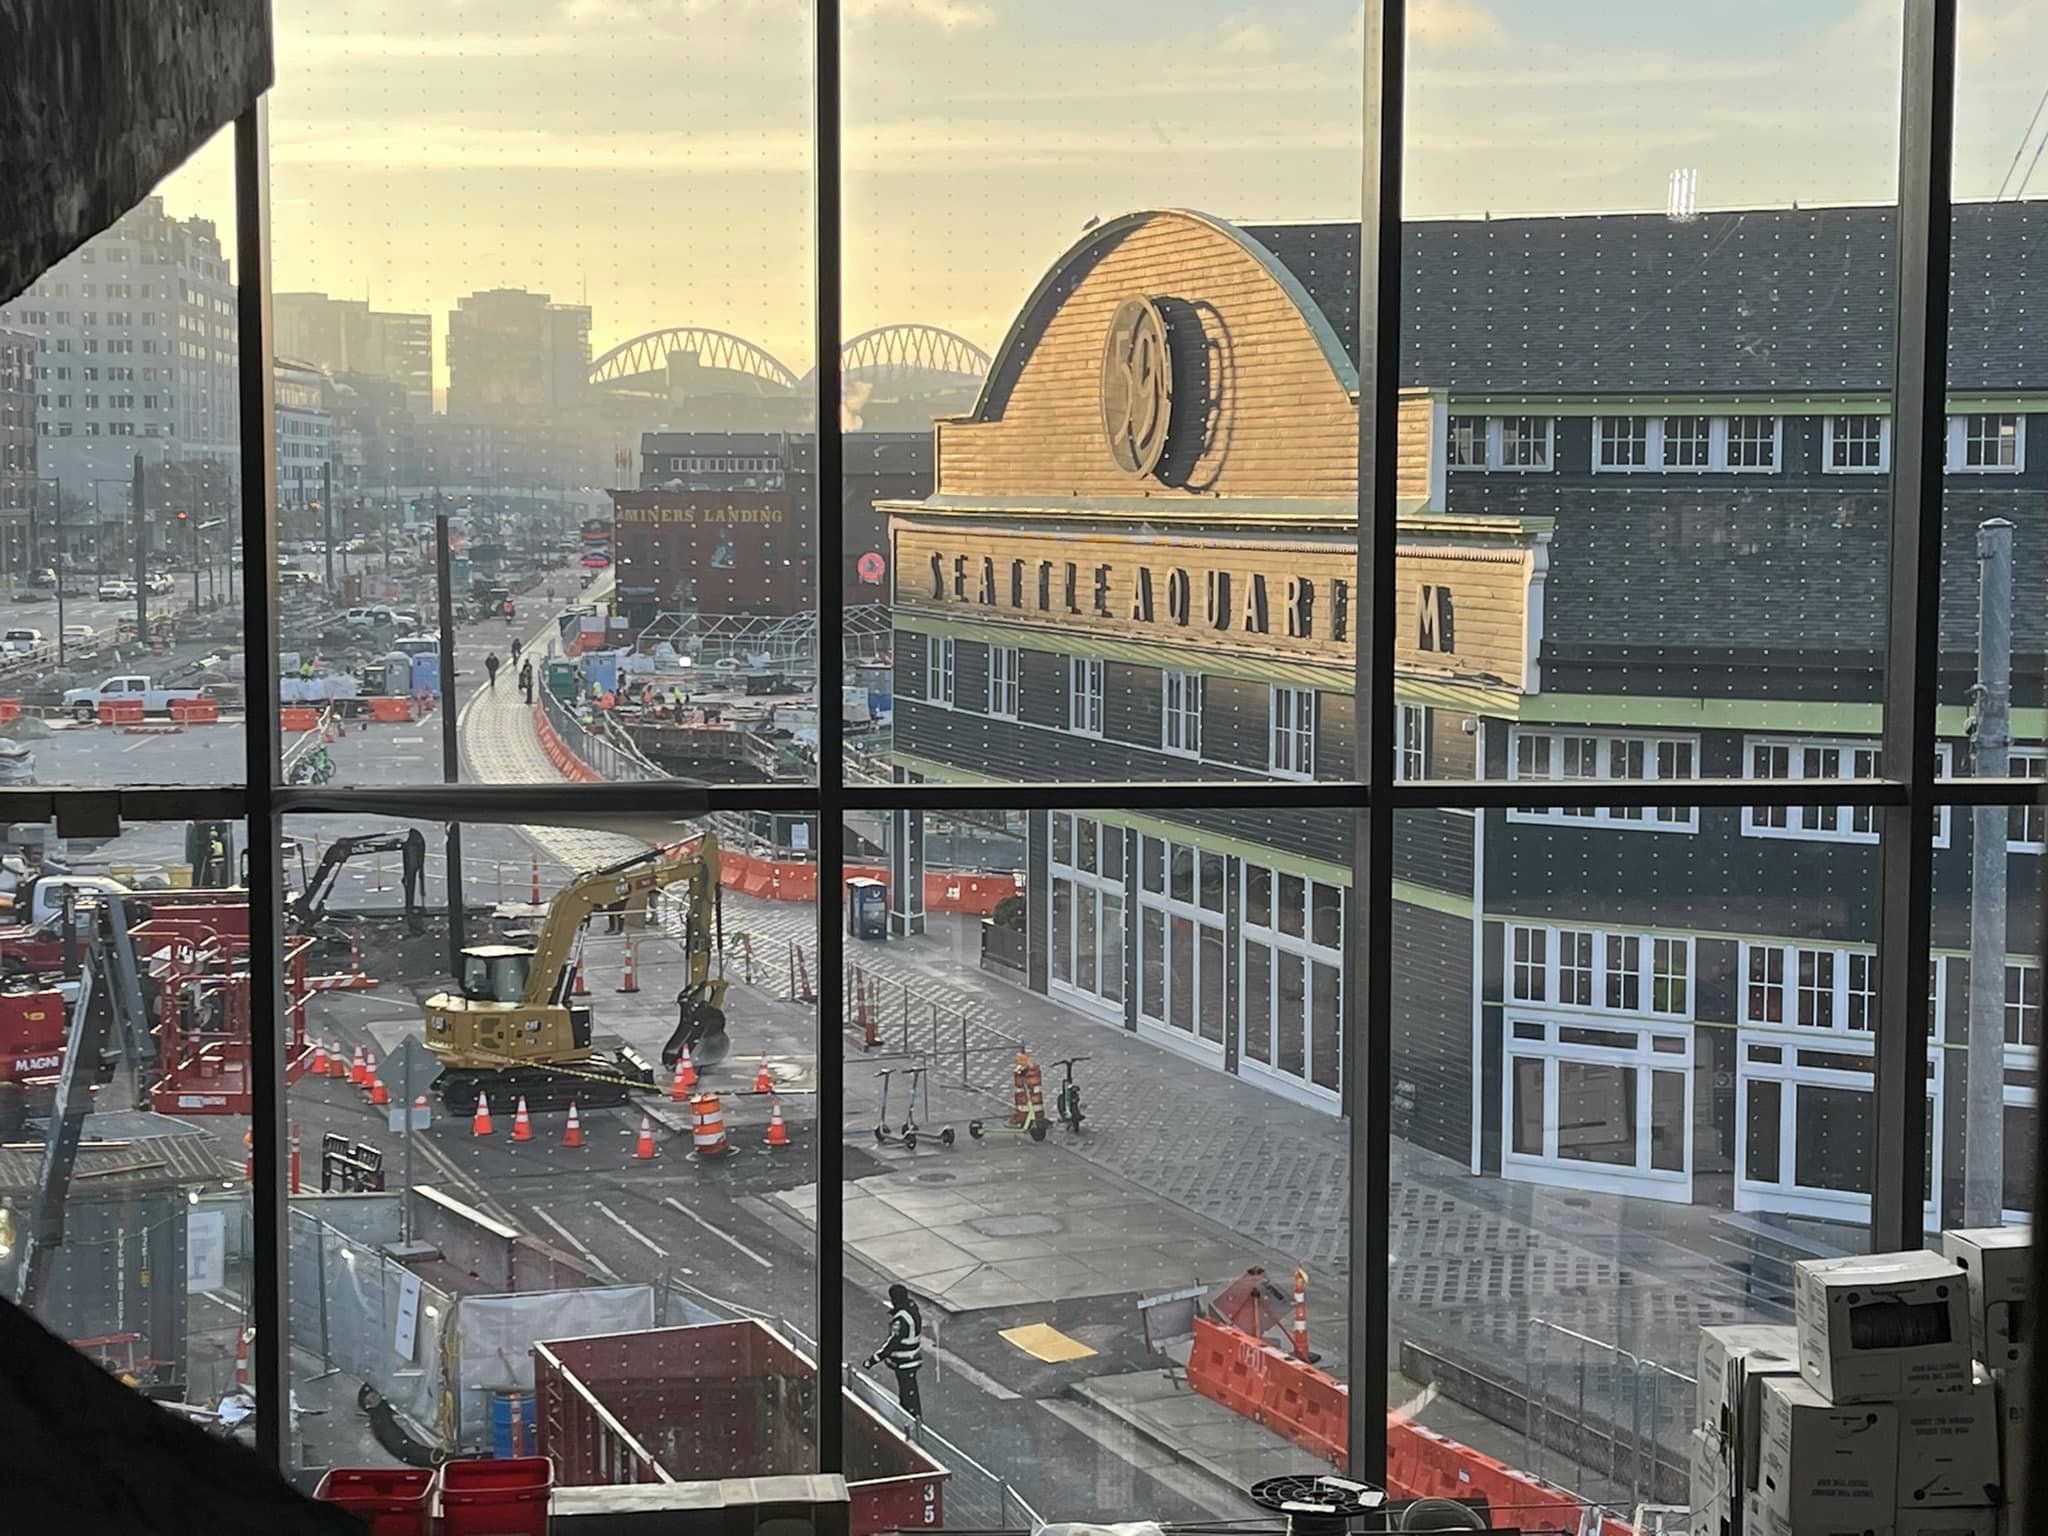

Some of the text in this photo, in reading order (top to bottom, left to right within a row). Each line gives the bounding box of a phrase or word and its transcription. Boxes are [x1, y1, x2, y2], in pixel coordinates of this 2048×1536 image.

[625, 508, 782, 523] MINERS LANDING
[928, 551, 1454, 654] SEATTLE AQUARIM
[16, 1056, 59, 1071] MAGNI
